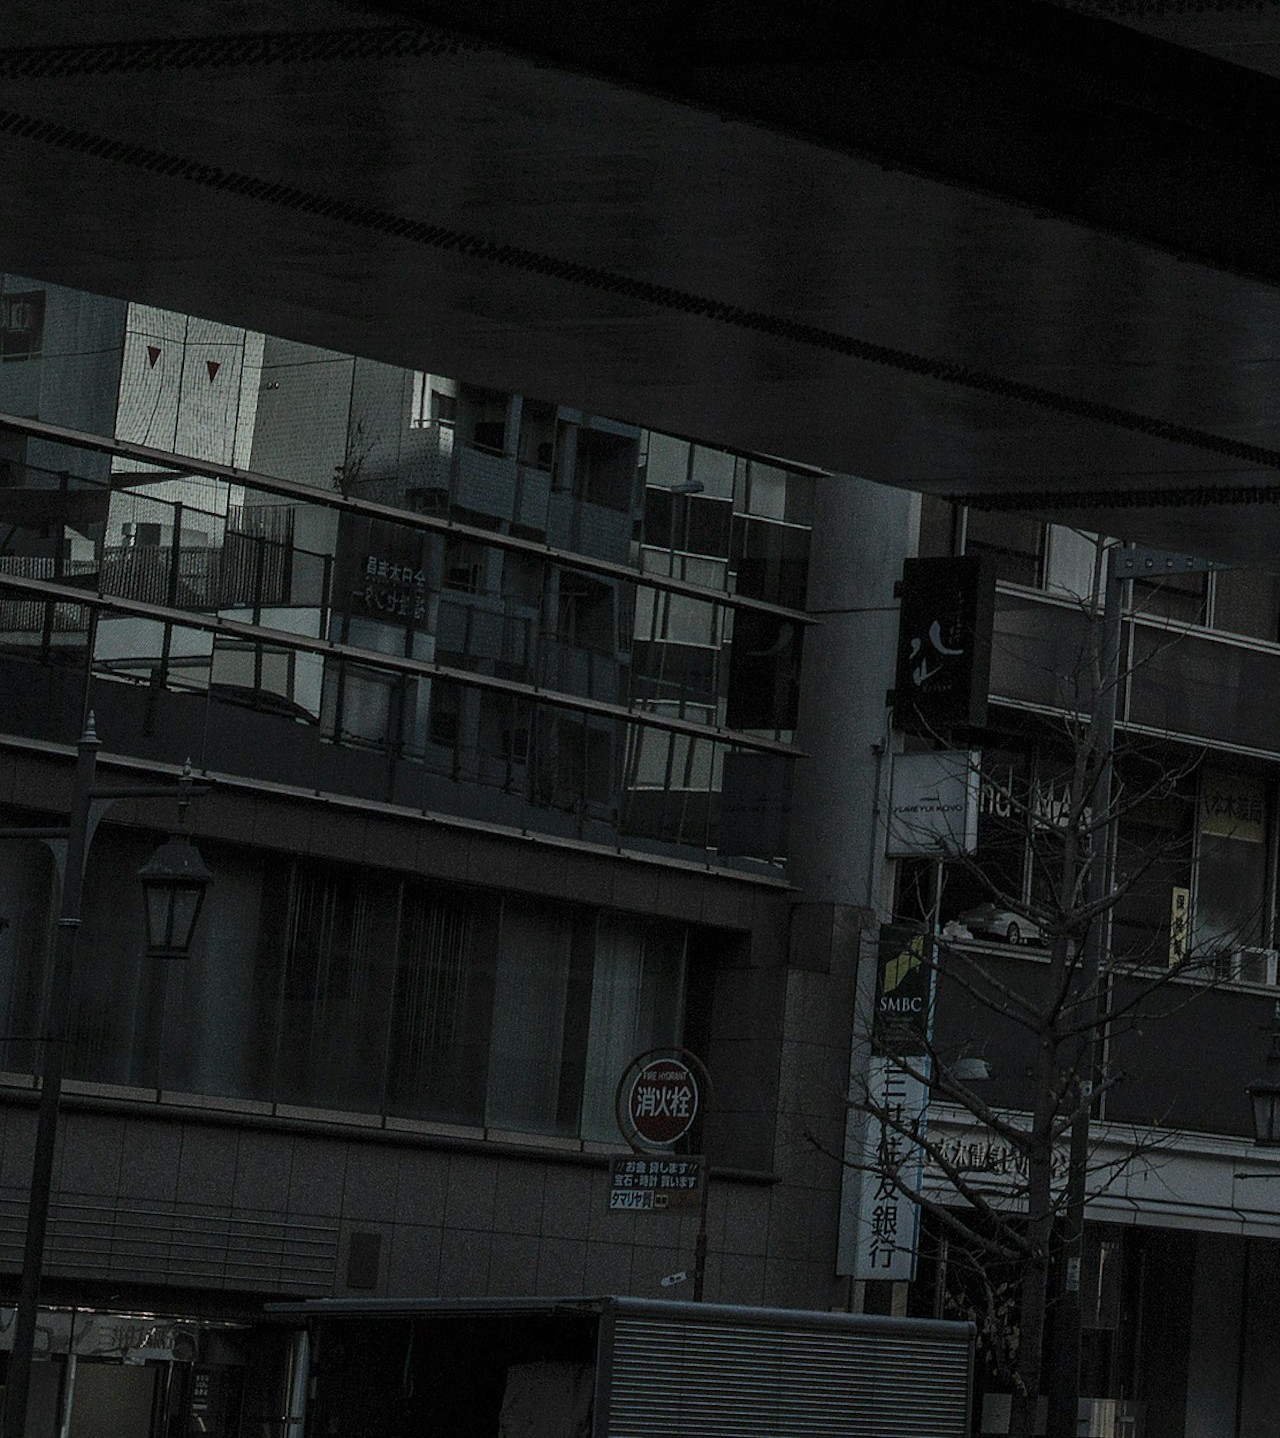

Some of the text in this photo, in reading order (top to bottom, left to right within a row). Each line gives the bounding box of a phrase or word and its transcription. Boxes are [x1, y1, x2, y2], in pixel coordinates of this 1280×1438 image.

[879, 996, 922, 1013] SMBC
[643, 1071, 688, 1081] FIRE HYDRANT
[635, 1086, 692, 1118] 消火栓
